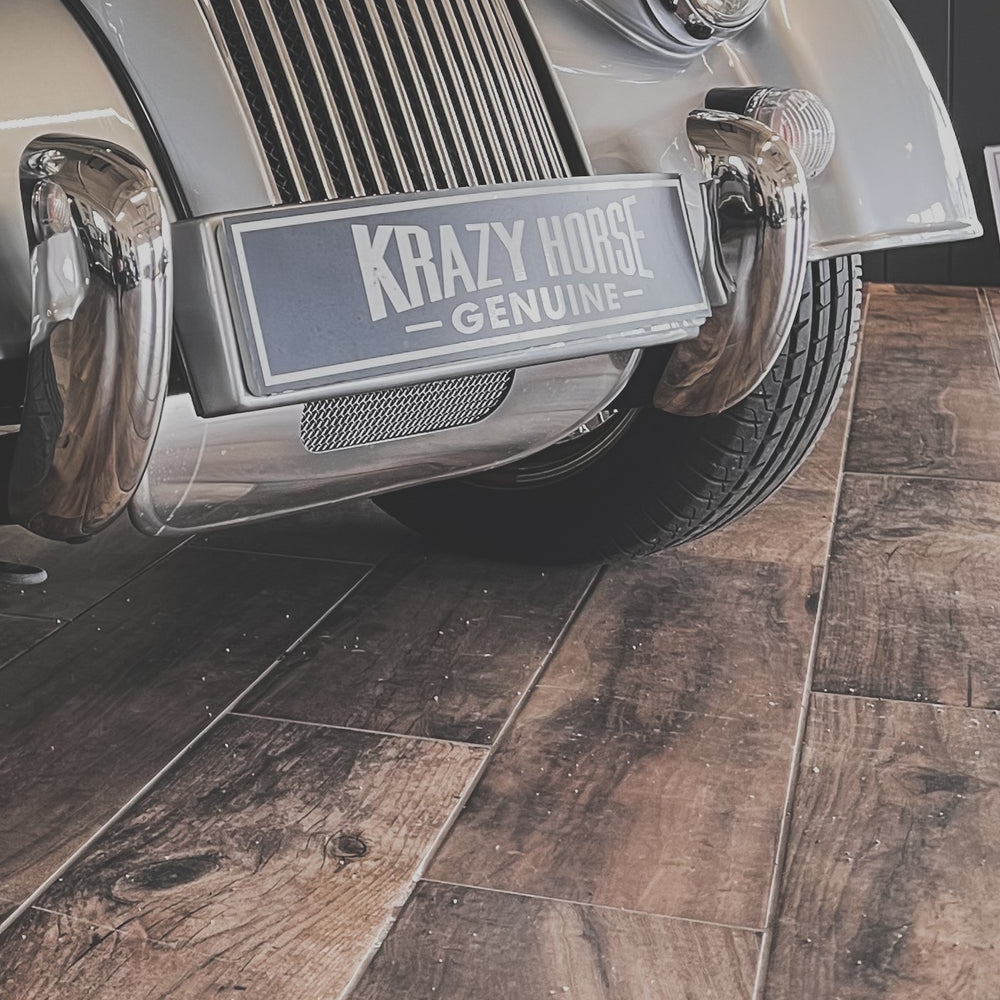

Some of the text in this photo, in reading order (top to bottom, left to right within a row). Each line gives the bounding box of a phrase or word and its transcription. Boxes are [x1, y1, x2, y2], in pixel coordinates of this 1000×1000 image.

[351, 195, 654, 322] KRAZY HORSE
[451, 282, 621, 335] GENUINE
